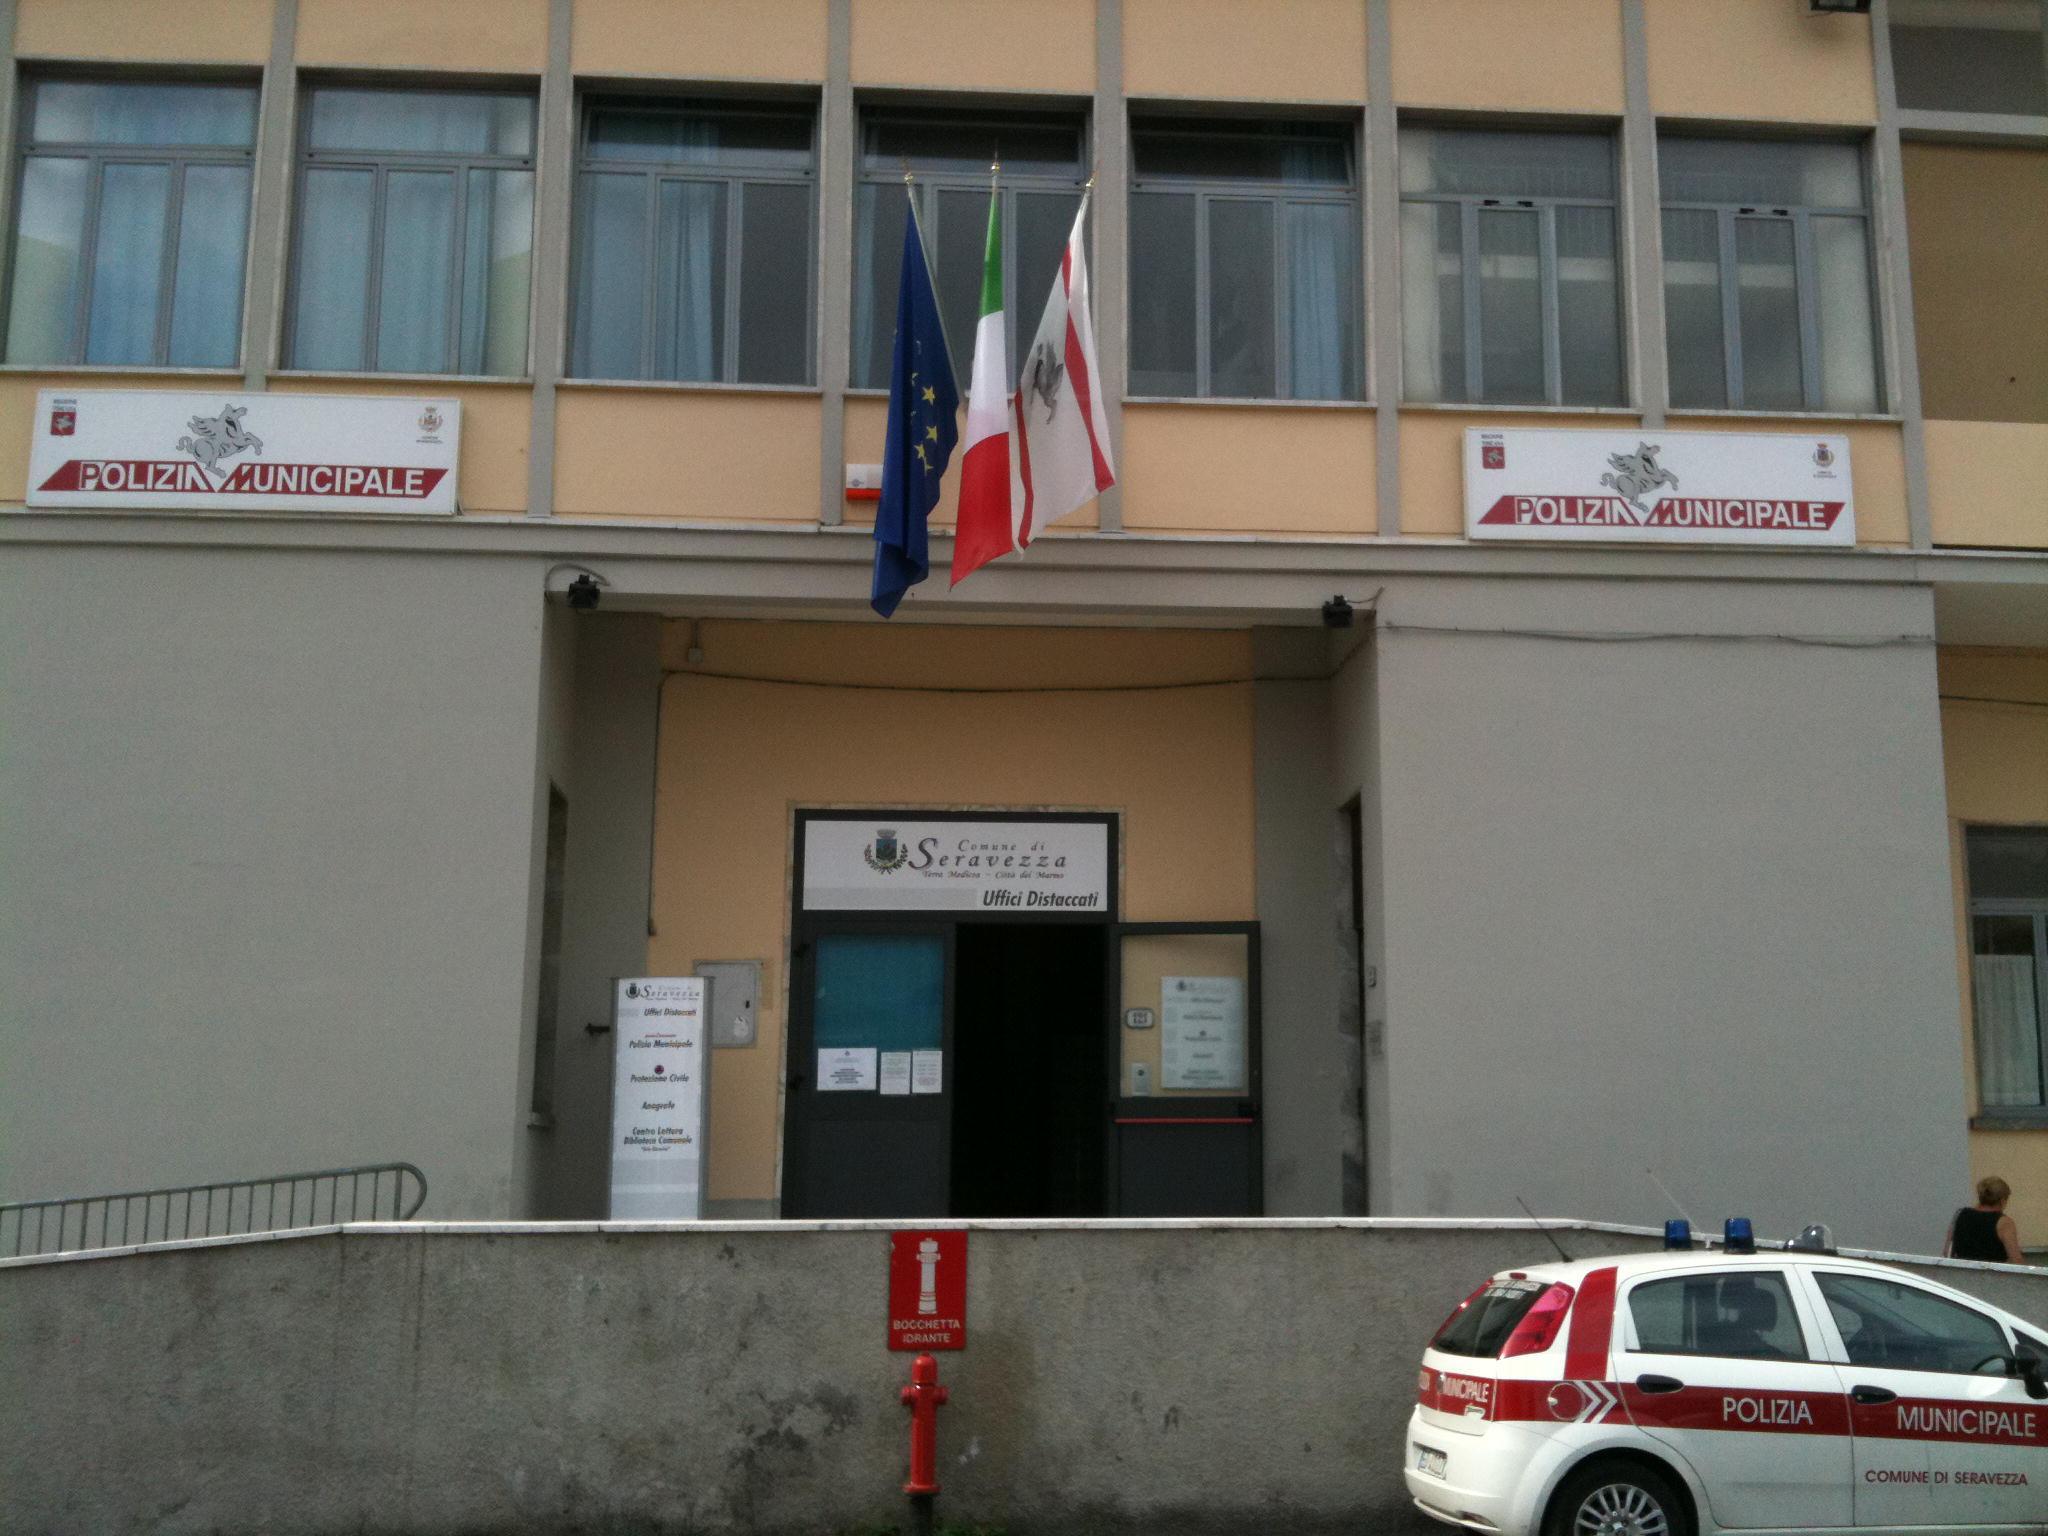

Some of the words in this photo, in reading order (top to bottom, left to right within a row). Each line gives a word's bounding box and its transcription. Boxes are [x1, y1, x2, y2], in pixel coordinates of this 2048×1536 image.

[79, 461, 208, 491] POLIZIA
[226, 465, 424, 496] MUNICIPALE
[1514, 496, 1636, 525] POLIZIA
[1650, 499, 1826, 528] MUNICIPALE
[908, 838, 1067, 869] Seravezza
[958, 839, 1017, 851] Comune
[1030, 841, 1045, 851] di
[983, 890, 1023, 907] Uffici
[1027, 890, 1099, 907] Distaccati
[893, 1319, 961, 1330] BOCCHETTA
[903, 1333, 951, 1343] IDRANTE
[1722, 1397, 1813, 1425] POLIZIA
[1897, 1405, 2036, 1437] MUNICIPALE
[1865, 1469, 1929, 1484] COMUNE
[1934, 1471, 1949, 1484] DI
[1954, 1471, 2028, 1486] SERAVEZZA
